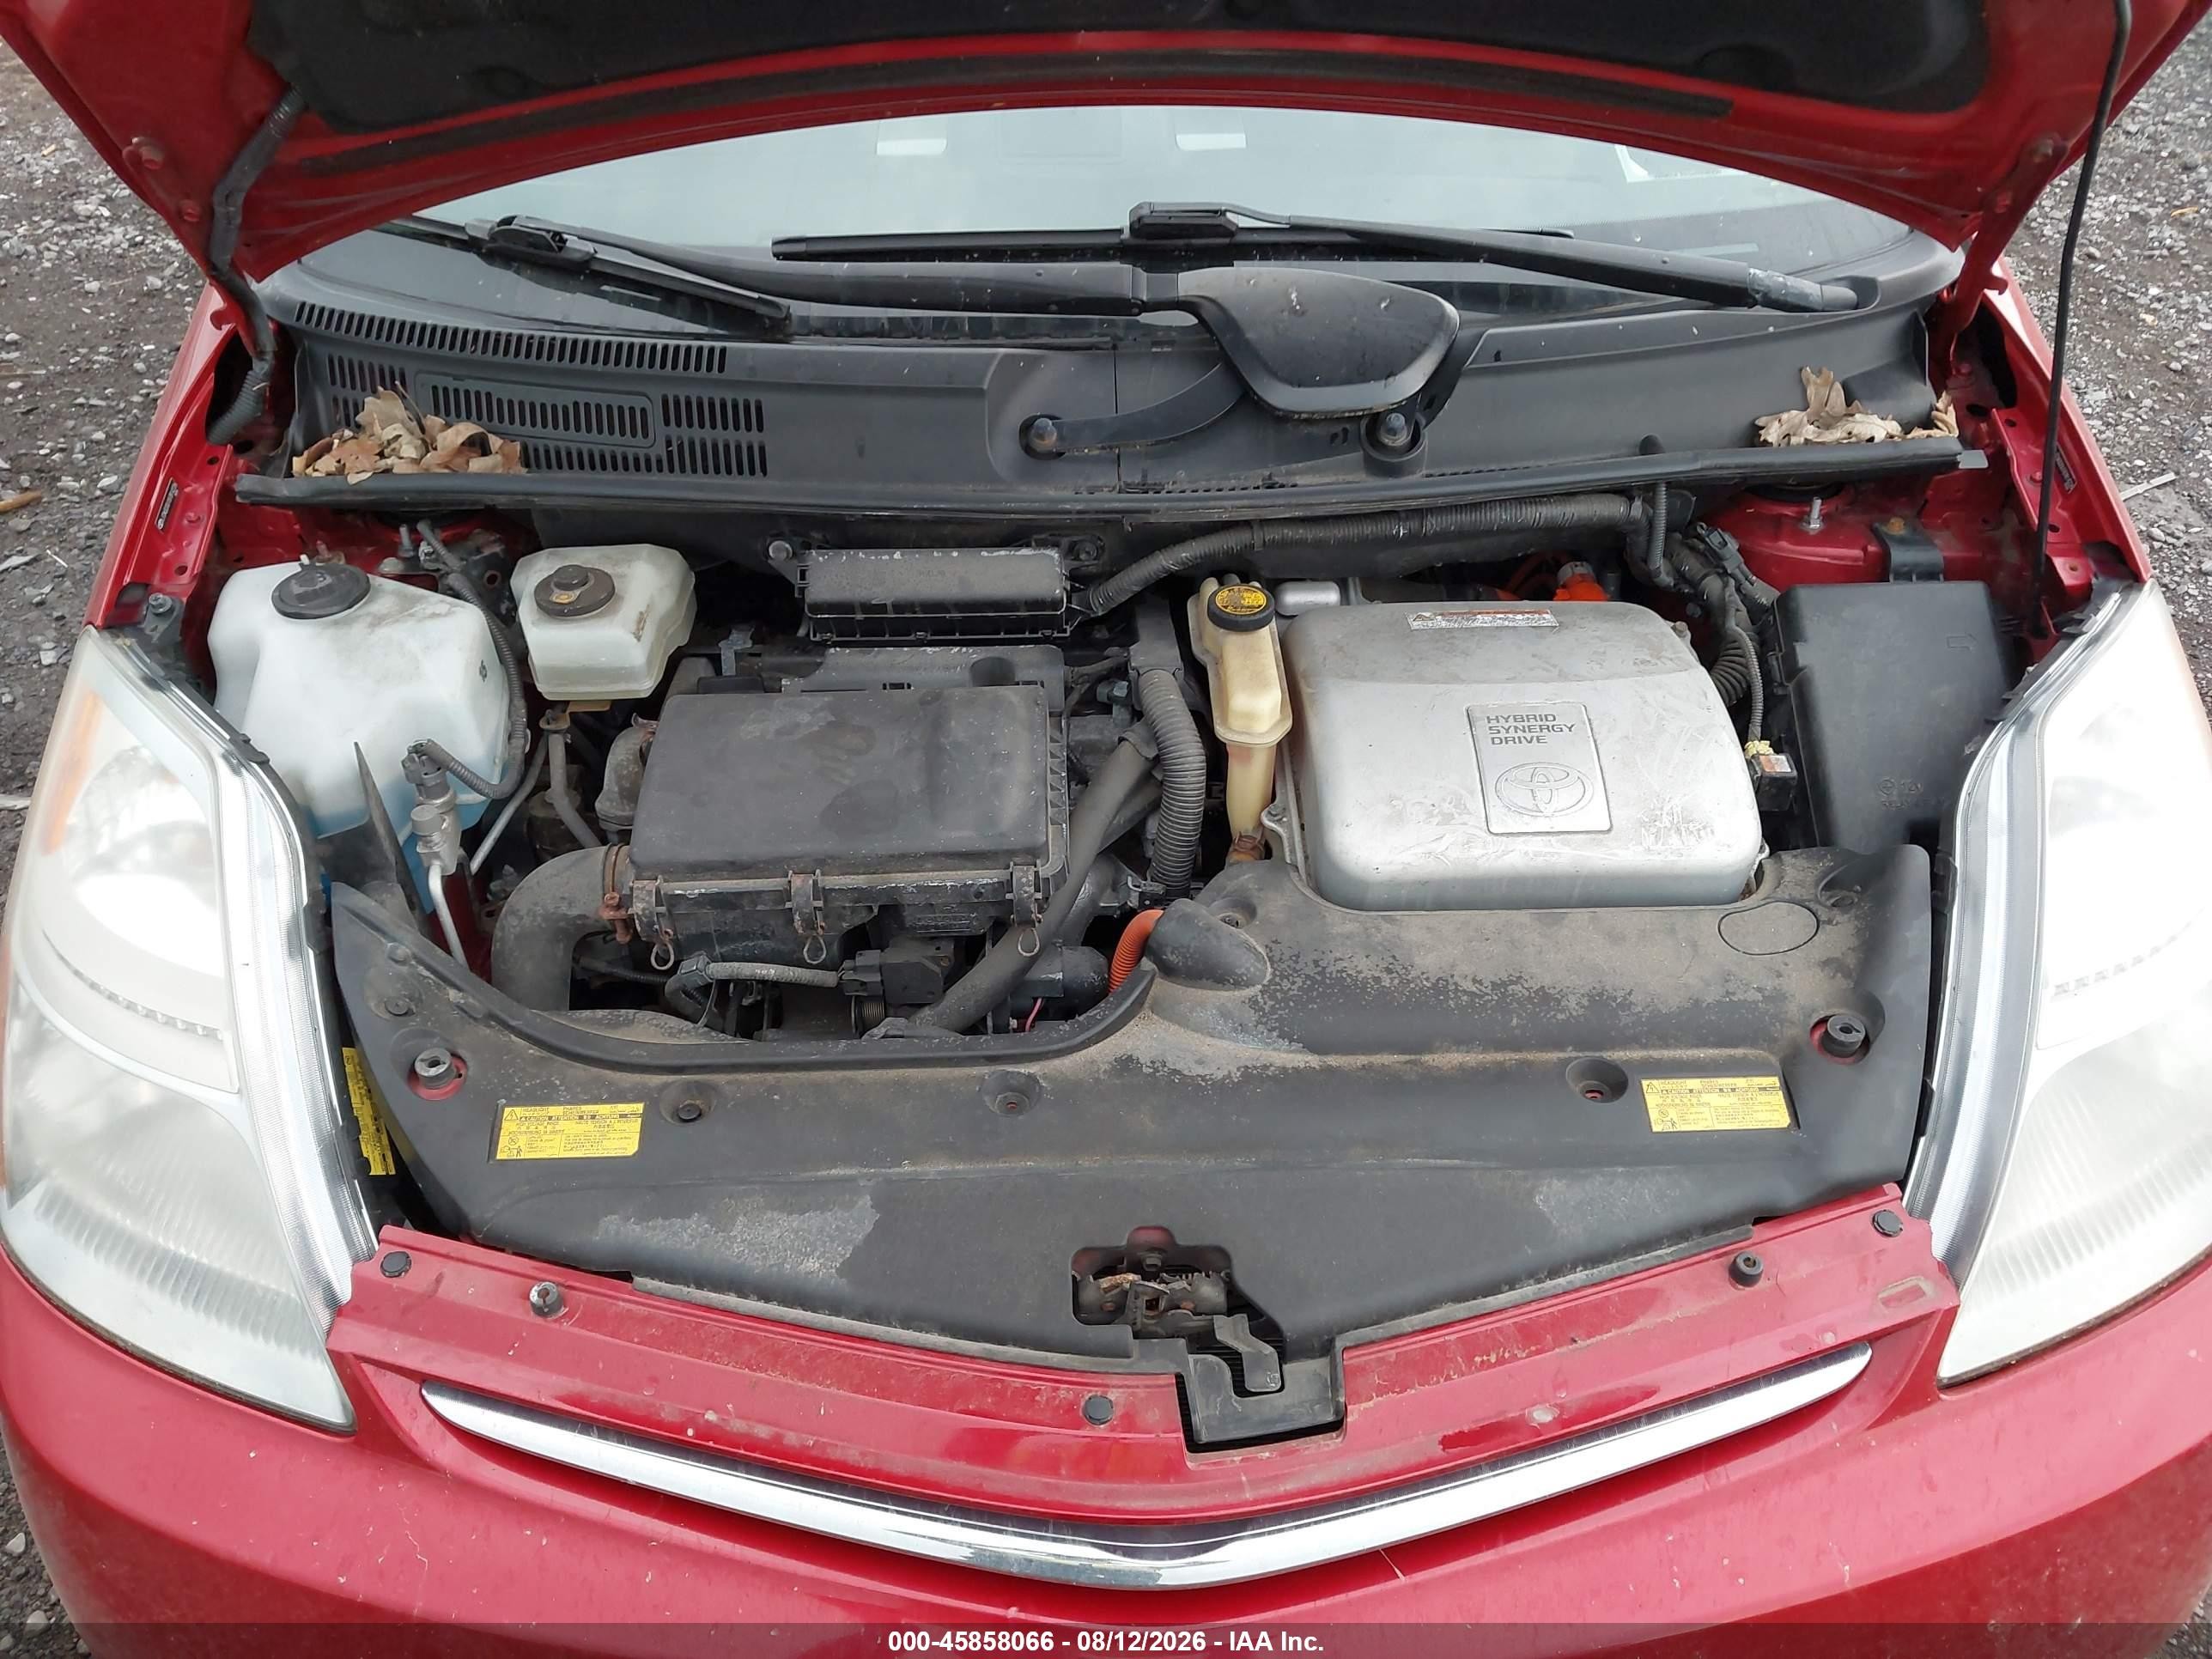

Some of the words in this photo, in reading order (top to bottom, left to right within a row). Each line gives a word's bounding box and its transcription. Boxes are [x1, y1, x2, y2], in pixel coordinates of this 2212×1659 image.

[1486, 714, 1557, 723] HYBRID
[1488, 724, 1575, 734] SYNERGY
[1491, 736, 1547, 745] DRIVE
